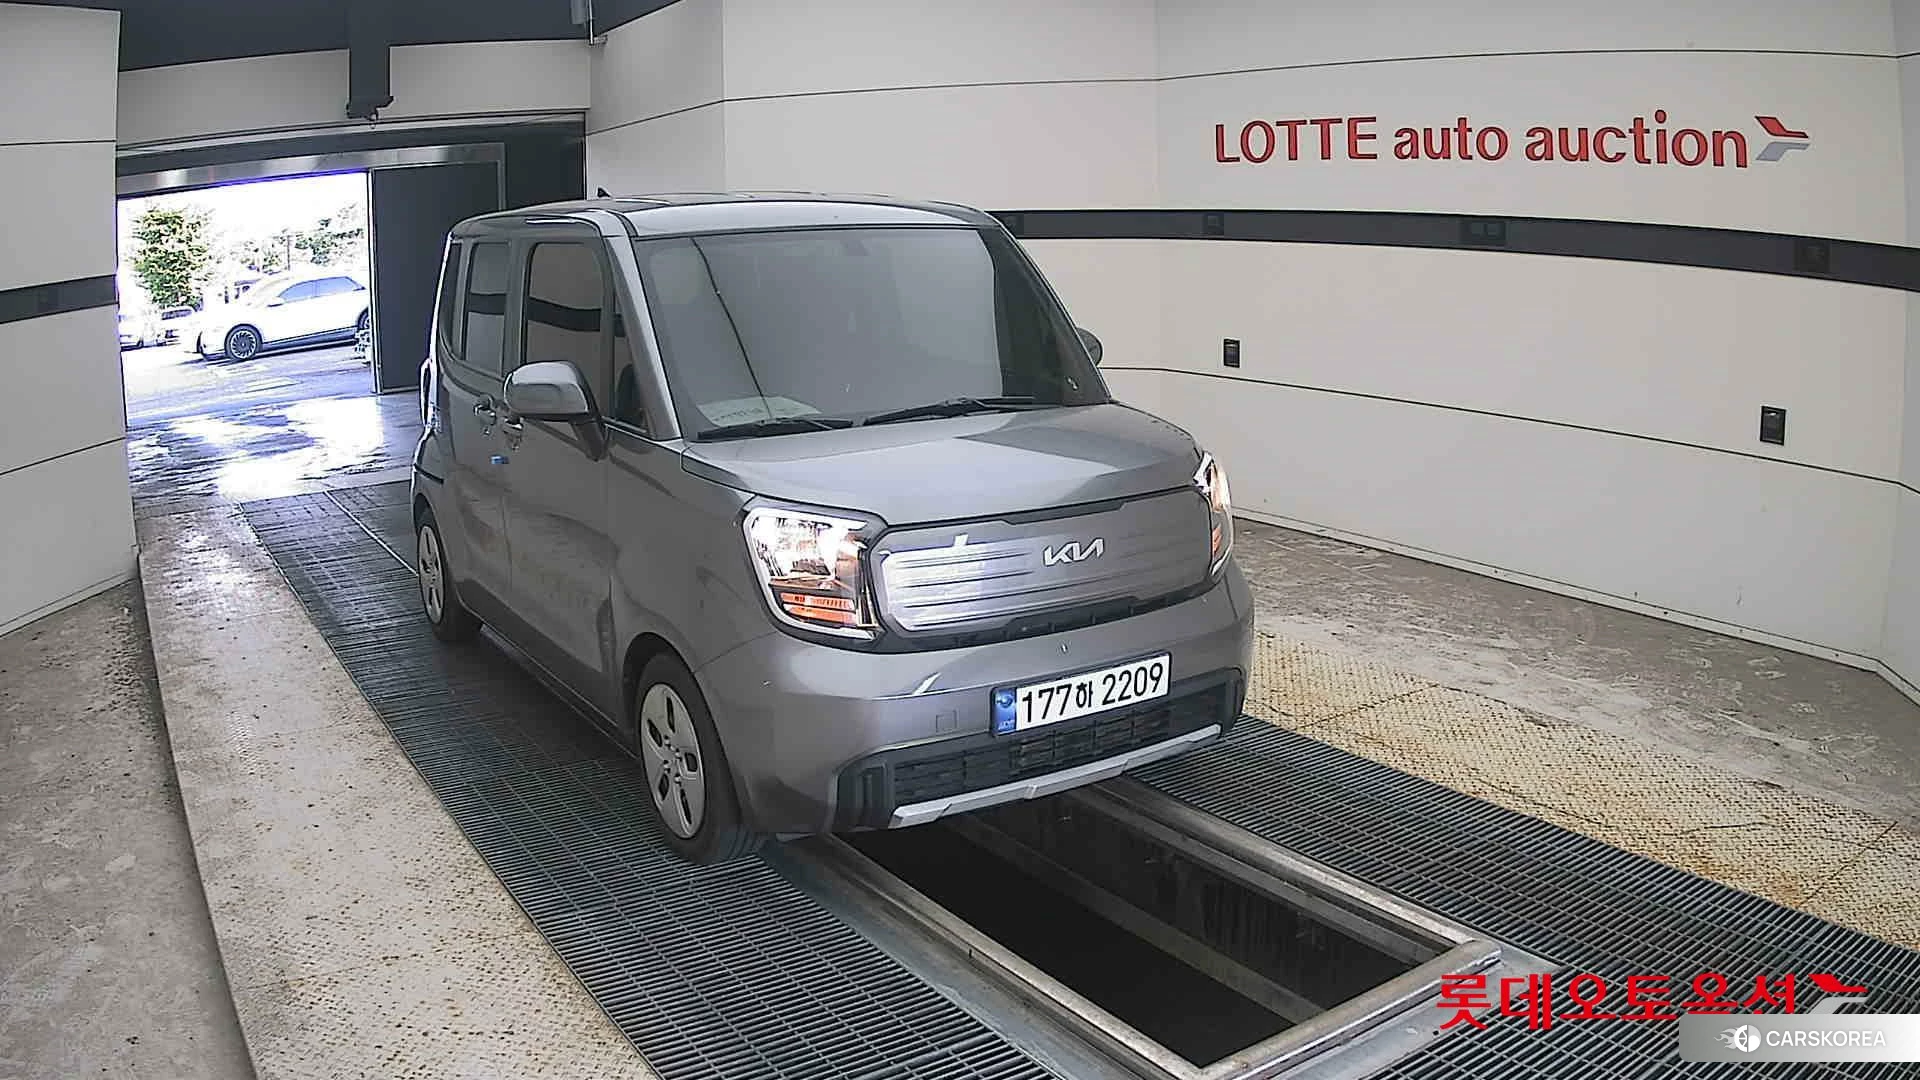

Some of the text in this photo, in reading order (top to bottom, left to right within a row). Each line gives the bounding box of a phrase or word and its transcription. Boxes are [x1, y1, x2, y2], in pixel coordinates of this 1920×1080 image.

[1215, 109, 1748, 168] LOTTE auto auction
[1043, 537, 1104, 566] KIA
[1022, 662, 1163, 722] 177하 2209
